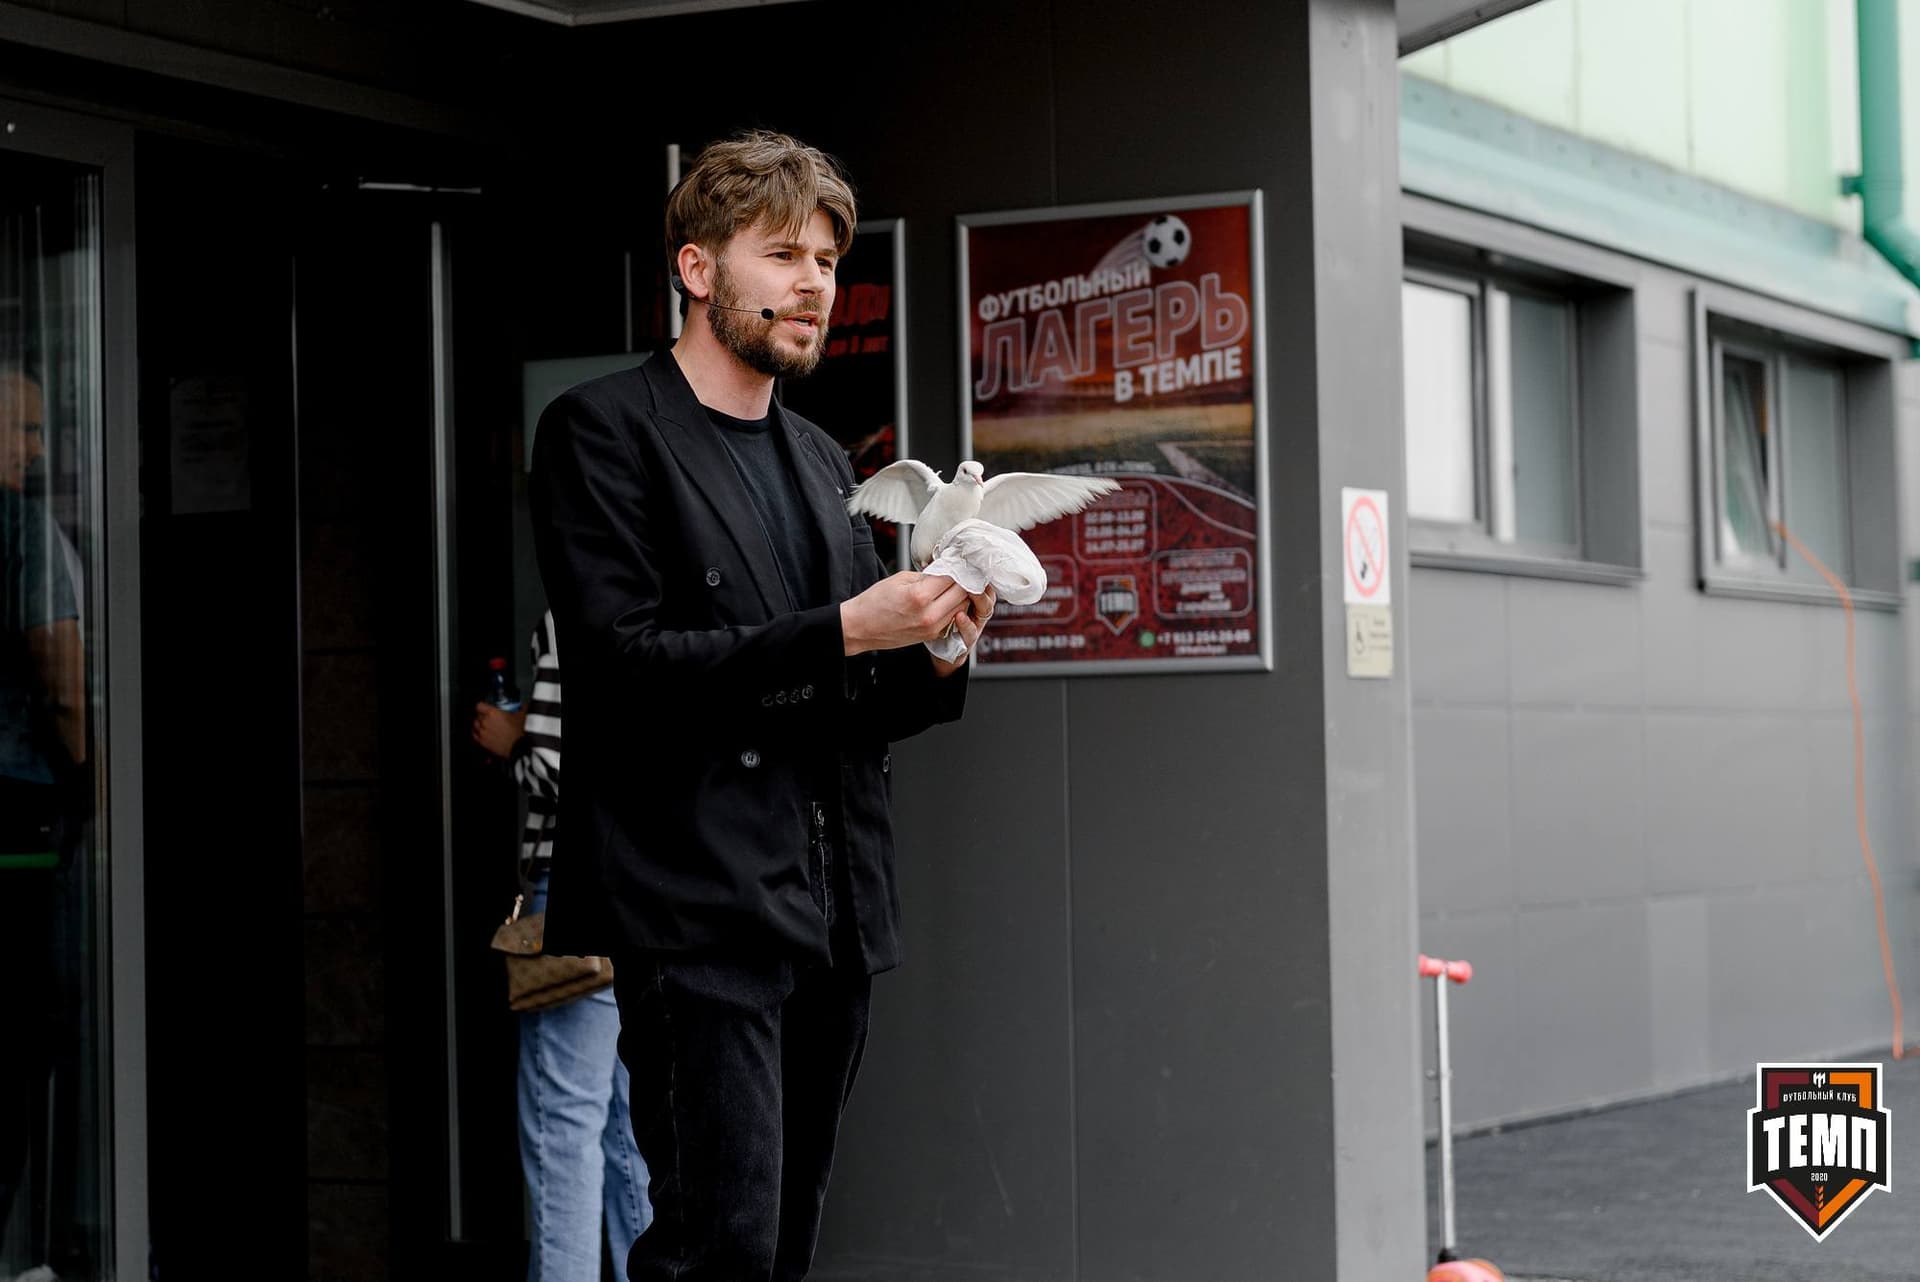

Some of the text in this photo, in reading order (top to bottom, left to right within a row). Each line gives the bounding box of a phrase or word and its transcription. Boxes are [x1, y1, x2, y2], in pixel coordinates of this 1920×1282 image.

[978, 261, 1150, 321] ФУТБОЛЬНЫЙ
[975, 272, 1248, 400] ЛАГЕРЬ
[1114, 346, 1243, 402] В ТЕМПЕ
